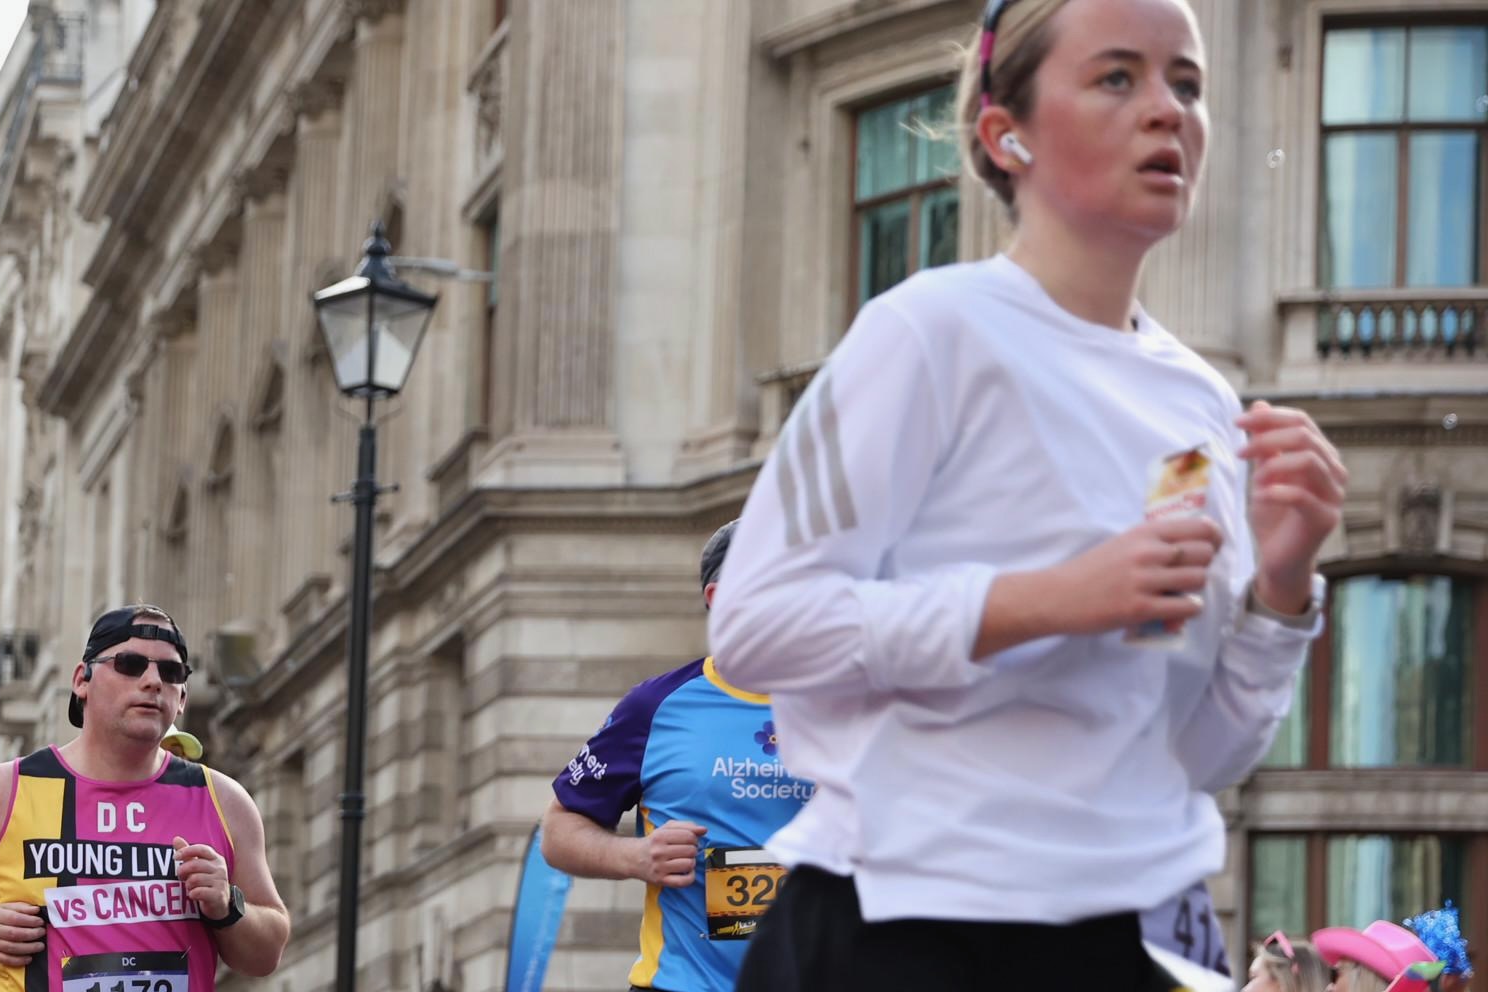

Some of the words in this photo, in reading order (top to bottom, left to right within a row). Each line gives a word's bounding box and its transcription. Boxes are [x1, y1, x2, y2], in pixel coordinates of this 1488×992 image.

[731, 779, 816, 804] Society
[29, 842, 123, 876] YOUNG
[122, 956, 137, 966] DC
